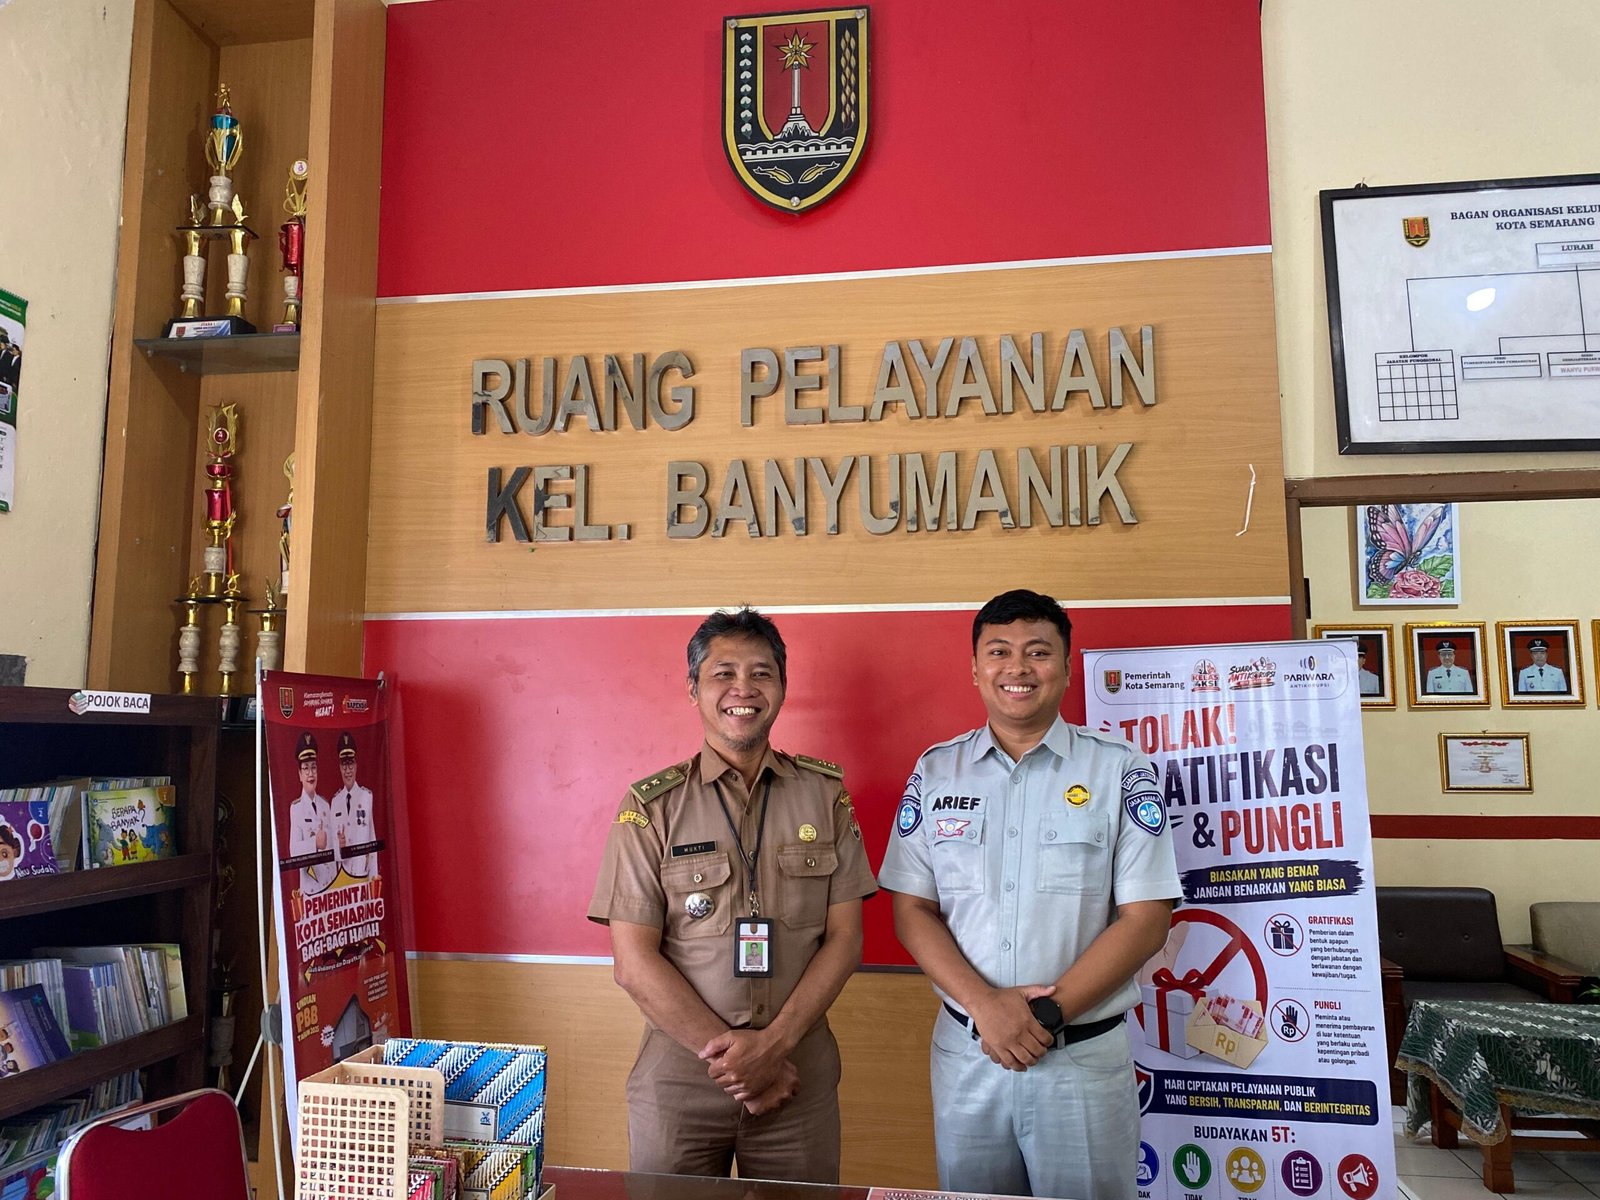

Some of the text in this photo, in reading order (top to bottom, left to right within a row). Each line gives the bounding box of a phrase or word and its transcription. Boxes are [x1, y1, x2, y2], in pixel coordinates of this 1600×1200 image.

[1451, 210, 1489, 220] BAGAN
[1492, 206, 1564, 218] ORGANISASI
[1496, 217, 1595, 231] KOTA SEMARANG
[1561, 243, 1594, 252] LURAH
[472, 325, 1156, 436] RUANG PELAYANAN
[486, 442, 1139, 544] KEL. BANYUMANIK
[1124, 670, 1171, 681] Pemerintah
[1229, 665, 1253, 675] SUARA
[1284, 673, 1336, 682] PARIWARA
[1125, 680, 1186, 692] Kota Semarang
[87, 694, 149, 709] POJOK BACA
[1119, 704, 1238, 755] TOLAK!
[1153, 743, 1341, 808] ATIFIKASI
[931, 795, 982, 812] ARIEF
[1129, 798, 1142, 807] JASA
[111, 806, 137, 820] BERAPA
[1192, 801, 1344, 856] & PUNGLI
[683, 844, 705, 853] MUKTI
[15, 863, 55, 878] Aku Sudah
[1209, 864, 1319, 883] BIASAKAN YANG BENAR
[1193, 878, 1346, 899] JANGAN BENARKAN YANG BIASA
[1308, 915, 1354, 926] GRATIFIKASI
[295, 917, 326, 947] KOTA
[1338, 929, 1354, 937] dalam
[1324, 946, 1359, 954] berhubungan
[1342, 963, 1363, 971] dengan
[1312, 972, 1358, 980] kewajiban/tugas.
[1314, 1000, 1342, 1010] PUNGLI
[295, 1004, 319, 1034] PBB
[1315, 1013, 1338, 1021] Meminta
[1283, 1025, 1295, 1037] Rp
[1342, 1024, 1375, 1032] pembayaran
[1333, 1031, 1361, 1039] ketentuan
[1215, 1032, 1236, 1056] Rp
[1317, 1048, 1370, 1057] kepentingan pribadi
[1164, 1078, 1316, 1098] MARI CIPTAKAN PELAYANAN PUBLIK
[1165, 1094, 1371, 1116] YANG BERSIH, TRANSPARAN, DAN BERINTEGRITAS
[1194, 1125, 1297, 1144] BUDAYAKAN 5T:
[1138, 1190, 1151, 1199] DAK
